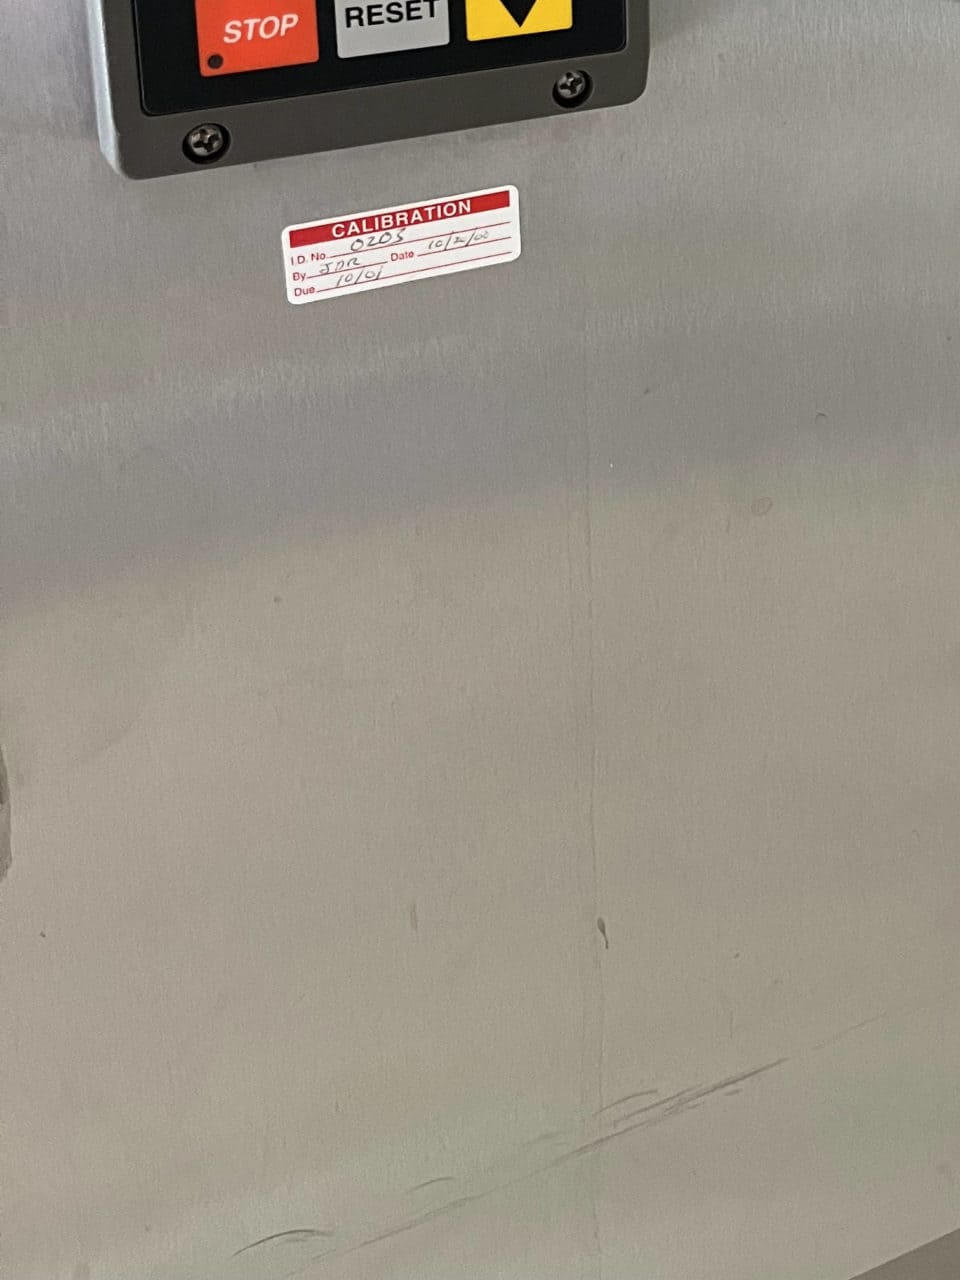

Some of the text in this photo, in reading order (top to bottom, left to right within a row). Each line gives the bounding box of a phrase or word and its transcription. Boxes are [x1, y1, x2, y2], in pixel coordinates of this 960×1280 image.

[222, 13, 300, 44] STOP
[331, 199, 472, 239] CALIBRATION
[390, 251, 415, 262] Date
[292, 271, 307, 282] By
[294, 286, 317, 297] Due
